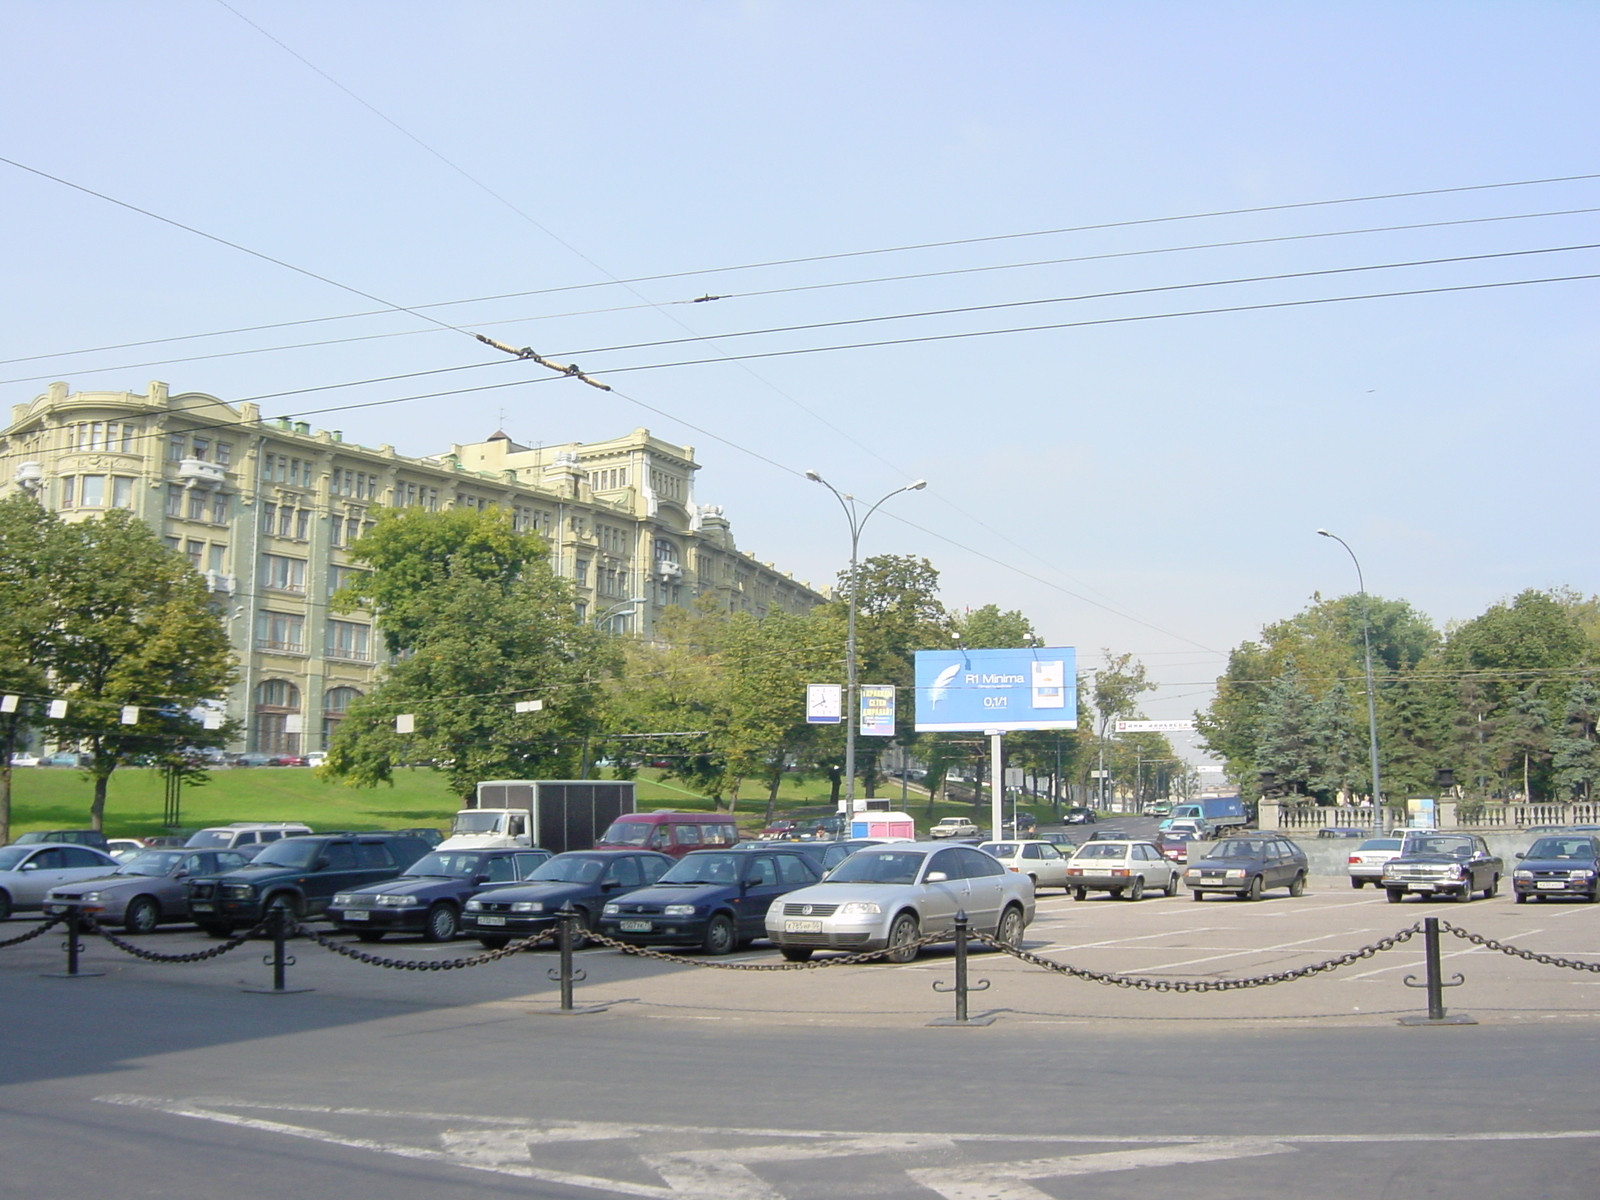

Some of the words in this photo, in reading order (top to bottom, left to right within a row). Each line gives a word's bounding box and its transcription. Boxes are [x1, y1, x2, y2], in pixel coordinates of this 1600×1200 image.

[965, 674, 979, 684] R1
[982, 674, 1025, 684] Minima
[983, 696, 1008, 708] 0,1/1
